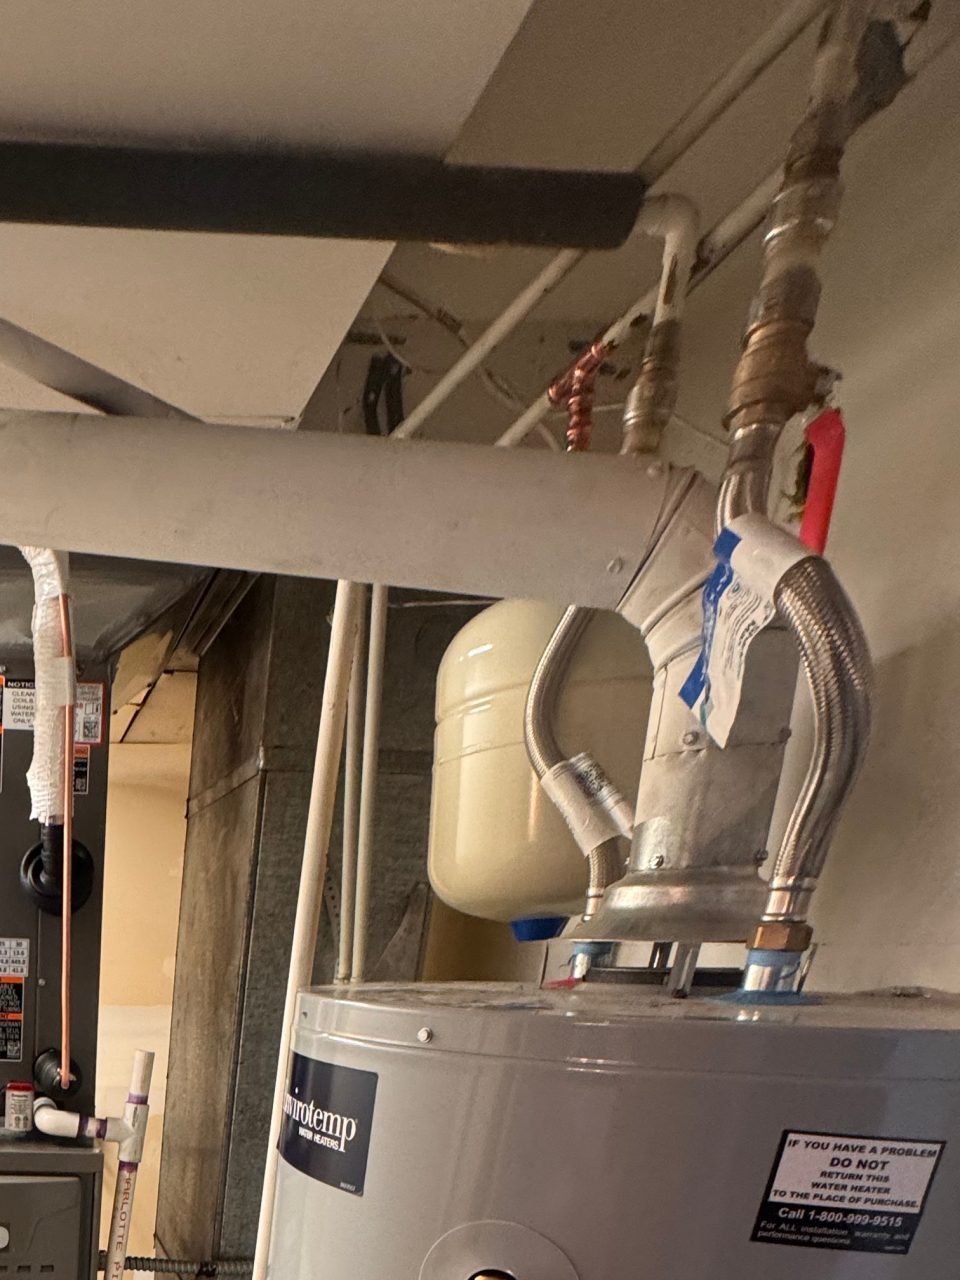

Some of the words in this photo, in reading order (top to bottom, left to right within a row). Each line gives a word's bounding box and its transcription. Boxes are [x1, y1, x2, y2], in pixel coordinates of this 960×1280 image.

[313, 1133, 339, 1150] HEATERS
[787, 1139, 800, 1147] IF
[803, 1140, 830, 1150] YOU
[832, 1143, 866, 1153] HAVE
[868, 1146, 878, 1154] A
[880, 1145, 937, 1158] PROBLEM
[829, 1157, 853, 1168] DO
[855, 1158, 889, 1171] NOT
[819, 1170, 863, 1181] RETURN
[864, 1173, 890, 1183] THIS
[810, 1181, 848, 1191] WATER
[849, 1184, 891, 1194] HEATER
[771, 1189, 787, 1197] TO
[788, 1191, 810, 1199] THE
[811, 1193, 846, 1202] PLACE
[115, 1173, 132, 1251] HARLOTTE
[777, 1207, 805, 1219] Call
